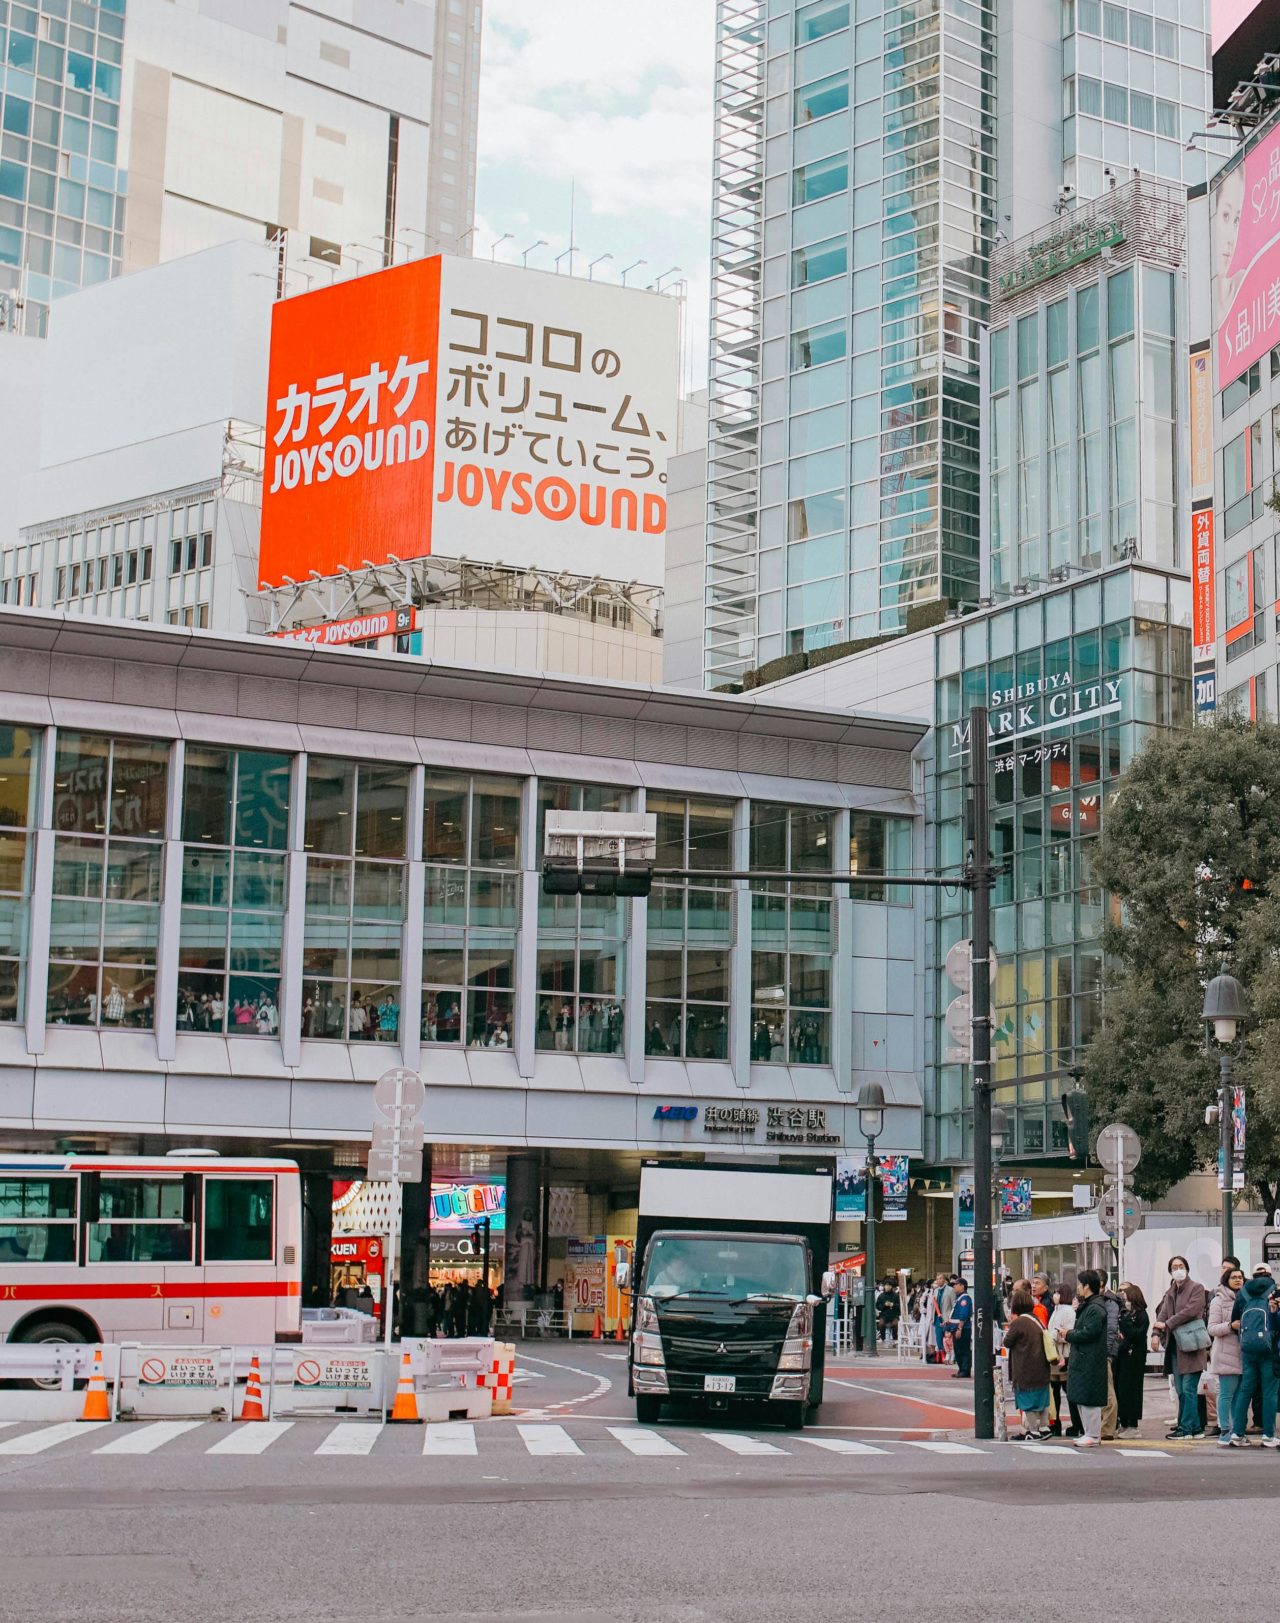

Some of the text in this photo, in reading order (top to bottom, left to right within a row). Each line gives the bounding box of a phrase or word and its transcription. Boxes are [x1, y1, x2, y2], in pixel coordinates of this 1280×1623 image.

[449, 307, 621, 378] ココロの
[273, 355, 429, 448] カラオケ
[447, 363, 667, 441] ボリューム、
[270, 420, 429, 494] JOYSOUND
[444, 416, 668, 484] あげていこう。
[437, 461, 667, 535] JOYSOUND
[1196, 513, 1210, 584] 外貨両替
[324, 615, 389, 643] JOYSOUND
[397, 613, 410, 627] 9F
[1199, 645, 1212, 656] 7F
[991, 671, 1071, 707] SHIBUYA
[1049, 678, 1123, 718] CITY
[994, 743, 1069, 775] 渋谷 マークシティ
[705, 1106, 759, 1123] 井の頭線
[767, 1106, 826, 1129] 渋谷駅
[766, 1132, 841, 1143] Shibuya Station
[3, 1285, 163, 1299] バ ス
